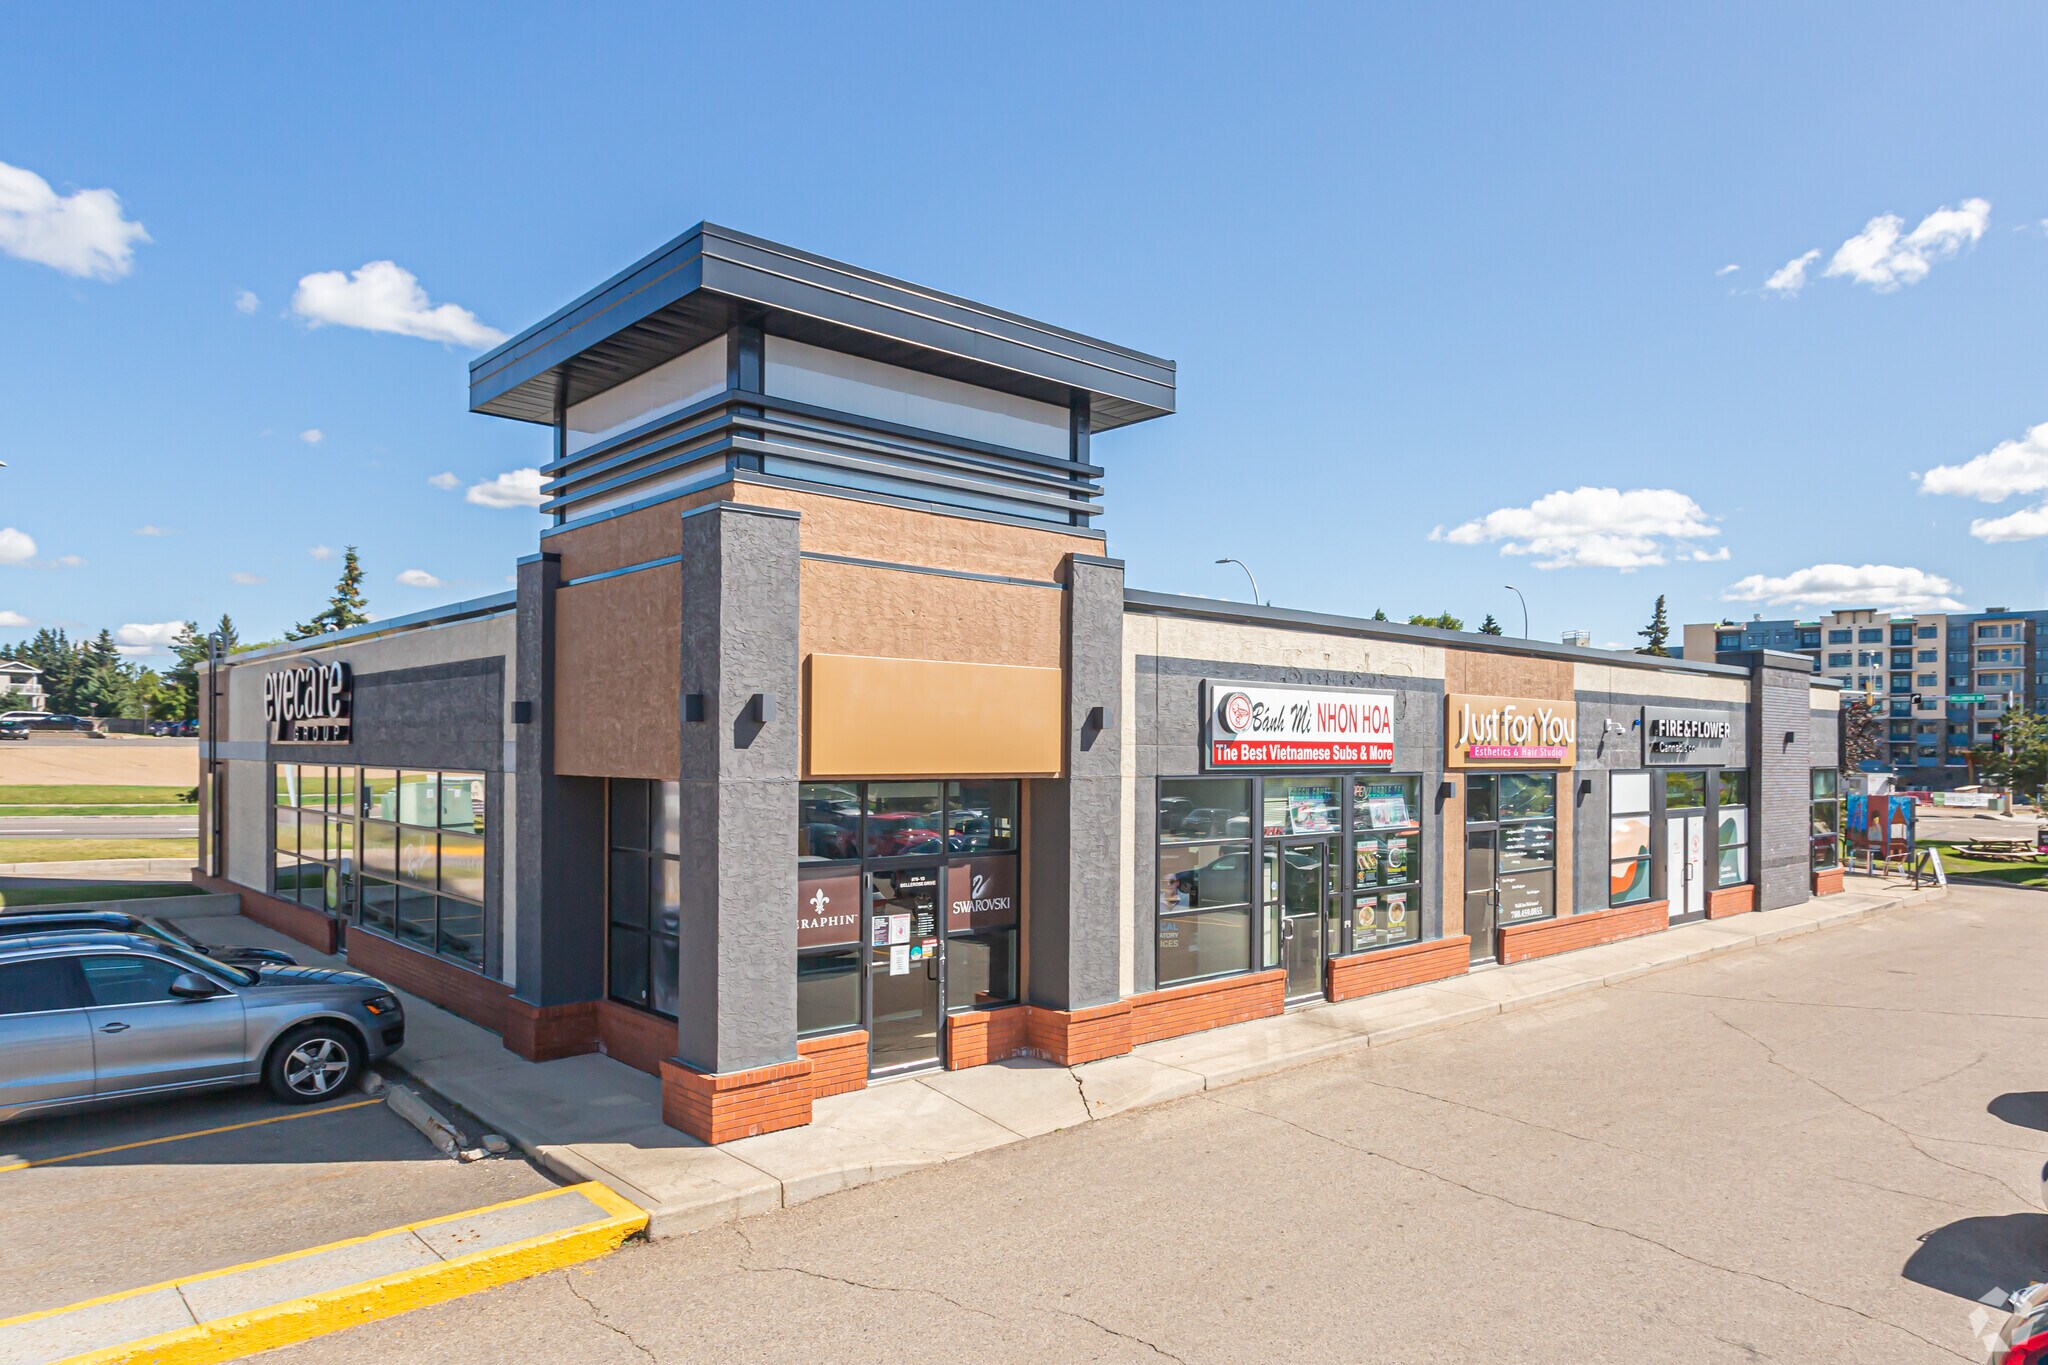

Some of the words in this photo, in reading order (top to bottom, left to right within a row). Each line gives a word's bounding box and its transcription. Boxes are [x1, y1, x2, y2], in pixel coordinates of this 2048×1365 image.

[263, 661, 342, 741] eyecare
[1252, 702, 1285, 732] Bánh
[1317, 703, 1358, 733] NHON
[1362, 705, 1391, 734] HOA
[1459, 703, 1500, 744] Just
[1504, 705, 1535, 742] For
[1537, 707, 1575, 743] You
[294, 725, 340, 741] GROUP
[1659, 719, 1731, 738] FIRE&FLOWER
[1215, 743, 1238, 761] The
[1241, 744, 1267, 761] Best
[1267, 744, 1331, 761] Vietnamese
[1332, 745, 1358, 760] Subs
[1360, 746, 1367, 760] &
[1369, 745, 1392, 760] More
[1474, 746, 1511, 757] Esthetics
[1513, 747, 1519, 756] &
[1521, 747, 1538, 757] Hair
[1539, 747, 1563, 757] Studio
[952, 897, 1010, 915] SWAROVSKI
